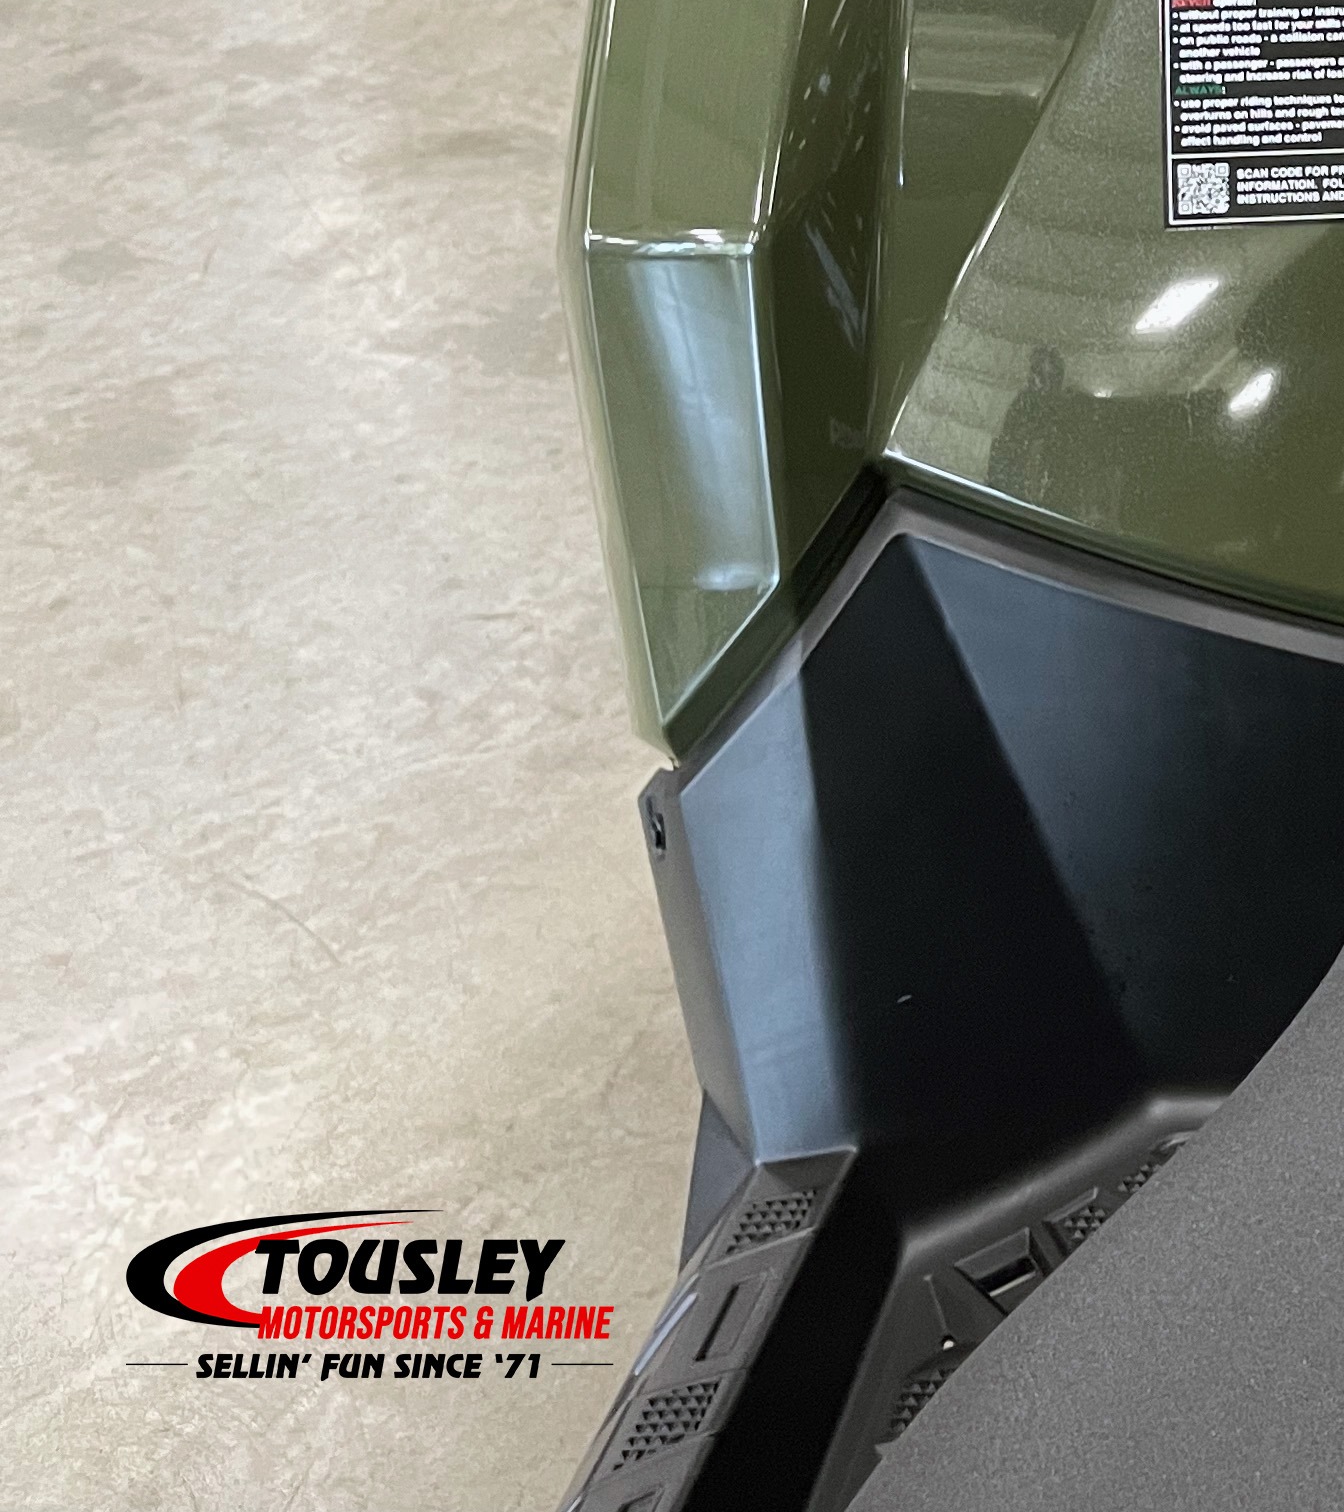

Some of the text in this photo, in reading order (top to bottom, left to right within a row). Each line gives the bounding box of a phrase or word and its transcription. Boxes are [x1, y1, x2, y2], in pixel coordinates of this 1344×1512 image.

[1237, 168, 1268, 180] SCAN
[1270, 167, 1303, 179] CODE
[1305, 166, 1328, 177] FOR
[1237, 179, 1318, 191] INFORMATION.
[1237, 190, 1320, 204] INSTRUCTIONS
